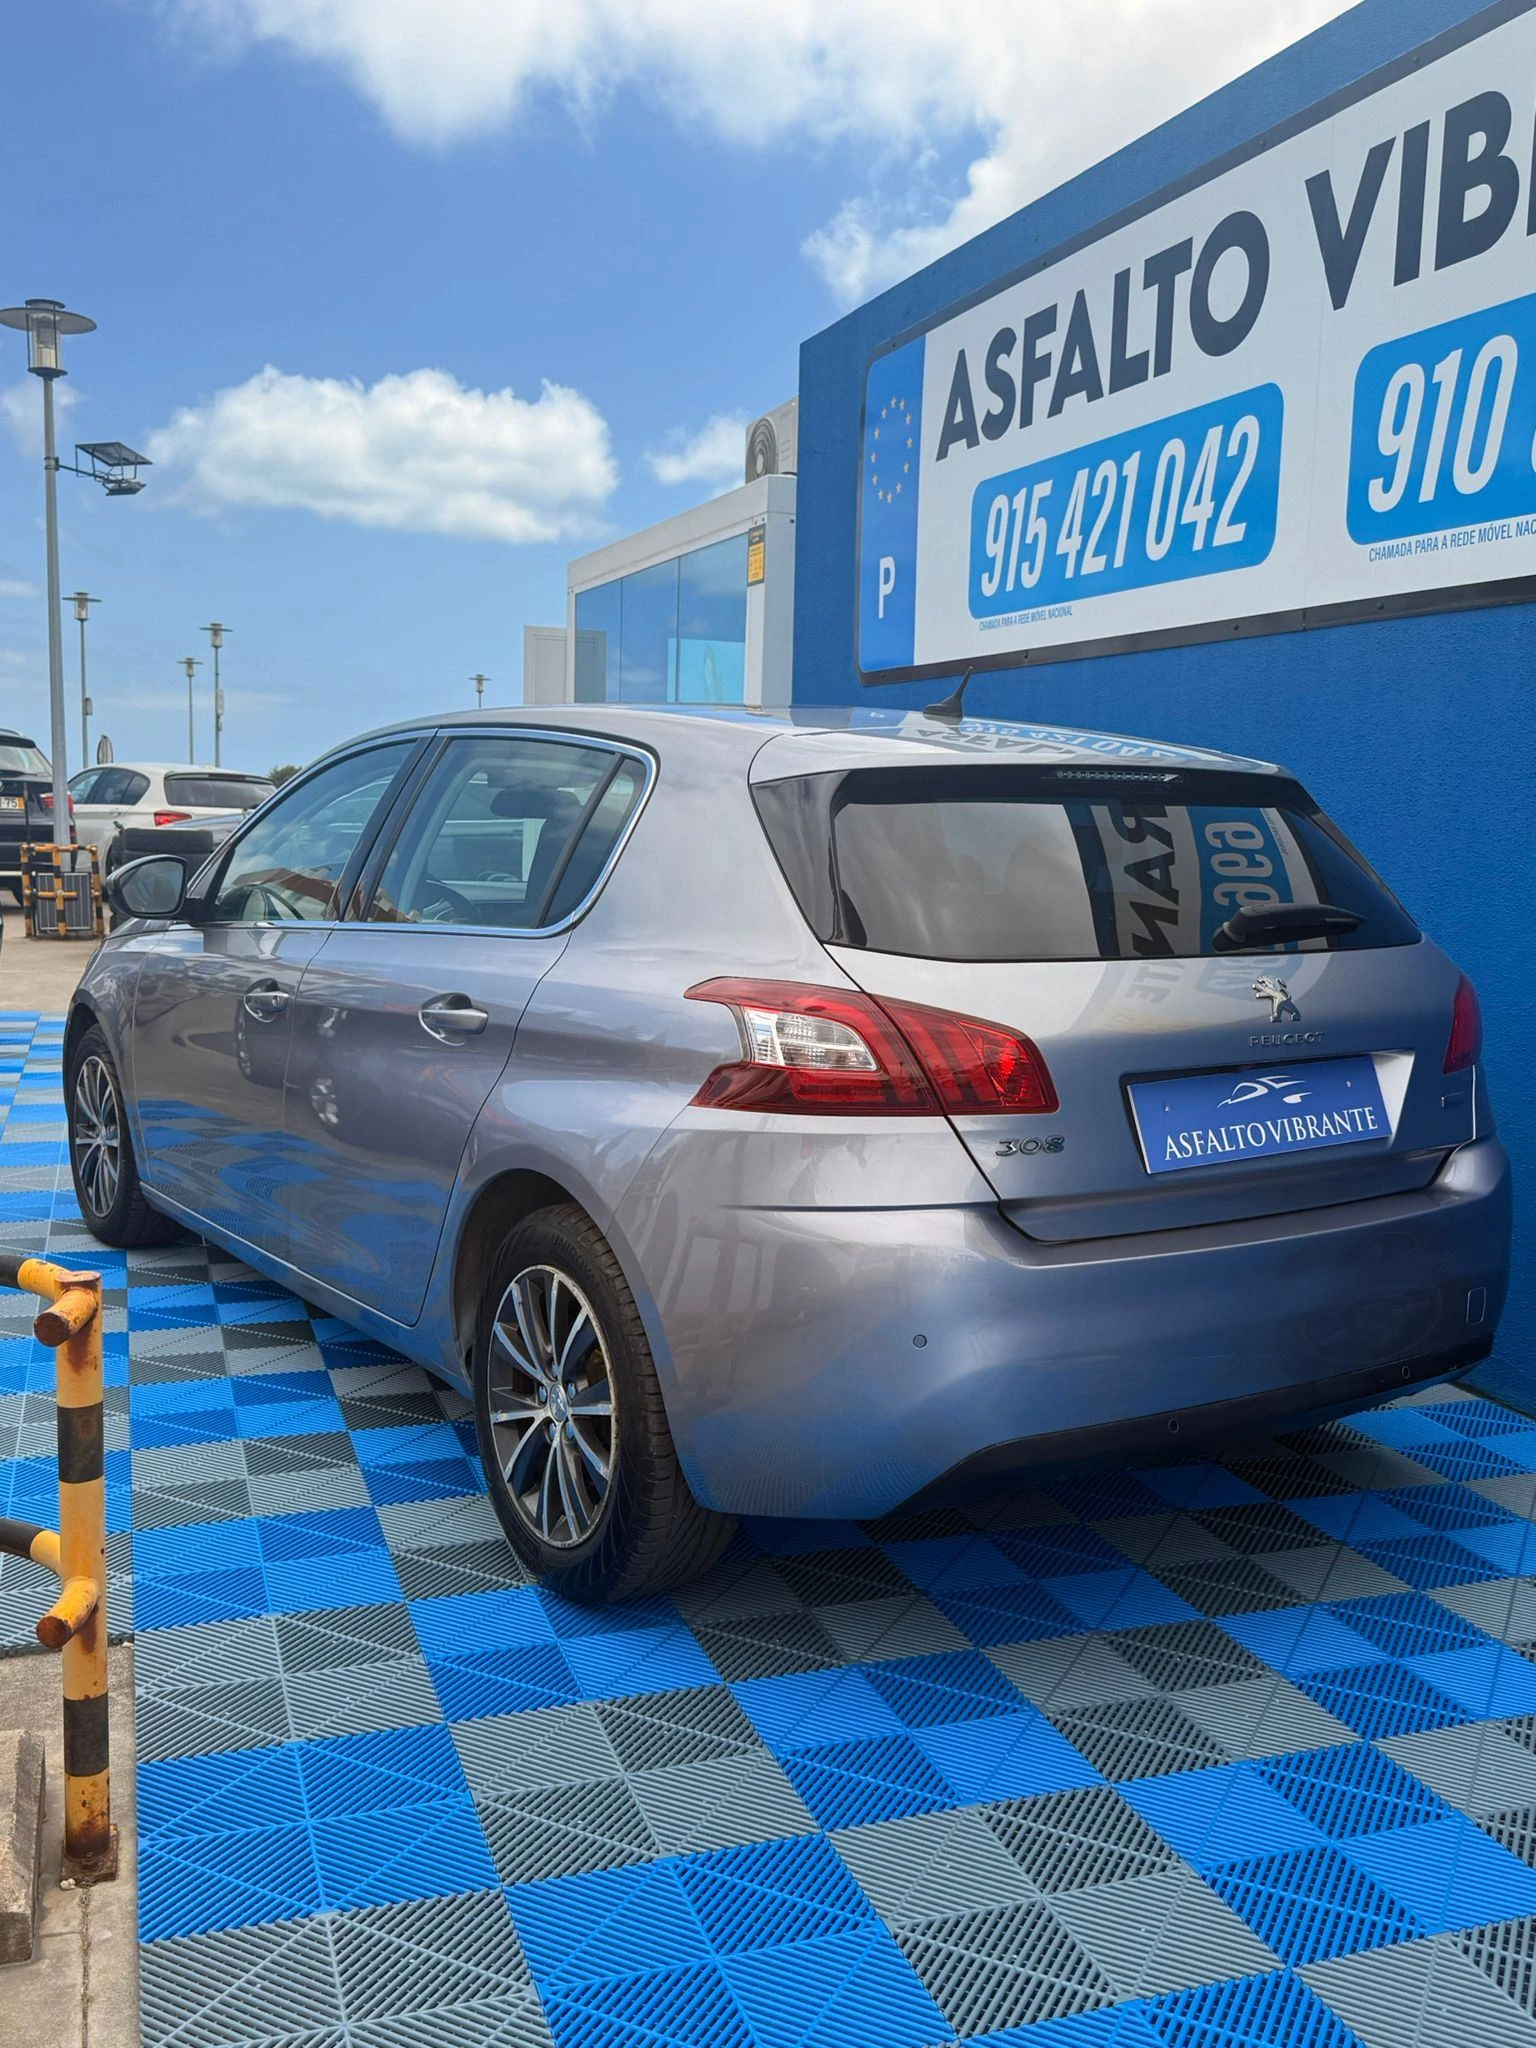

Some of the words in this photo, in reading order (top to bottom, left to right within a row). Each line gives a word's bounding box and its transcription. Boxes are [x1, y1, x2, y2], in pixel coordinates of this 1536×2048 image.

[935, 210, 1270, 462] ASFALTO
[1304, 90, 1536, 311] VIB
[1368, 334, 1518, 512] 910
[981, 480, 1053, 597] 915
[1056, 451, 1141, 579] 421
[1146, 415, 1260, 561] 042
[1369, 541, 1412, 562] CHAMADA
[1414, 535, 1438, 554] PARA
[1441, 535, 1448, 549] A
[1450, 529, 1476, 548] REDE
[1478, 523, 1512, 543] MÓVEL
[879, 556, 895, 619] P
[1250, 1031, 1325, 1048] PEUGEOT
[995, 1134, 1065, 1157] 308
